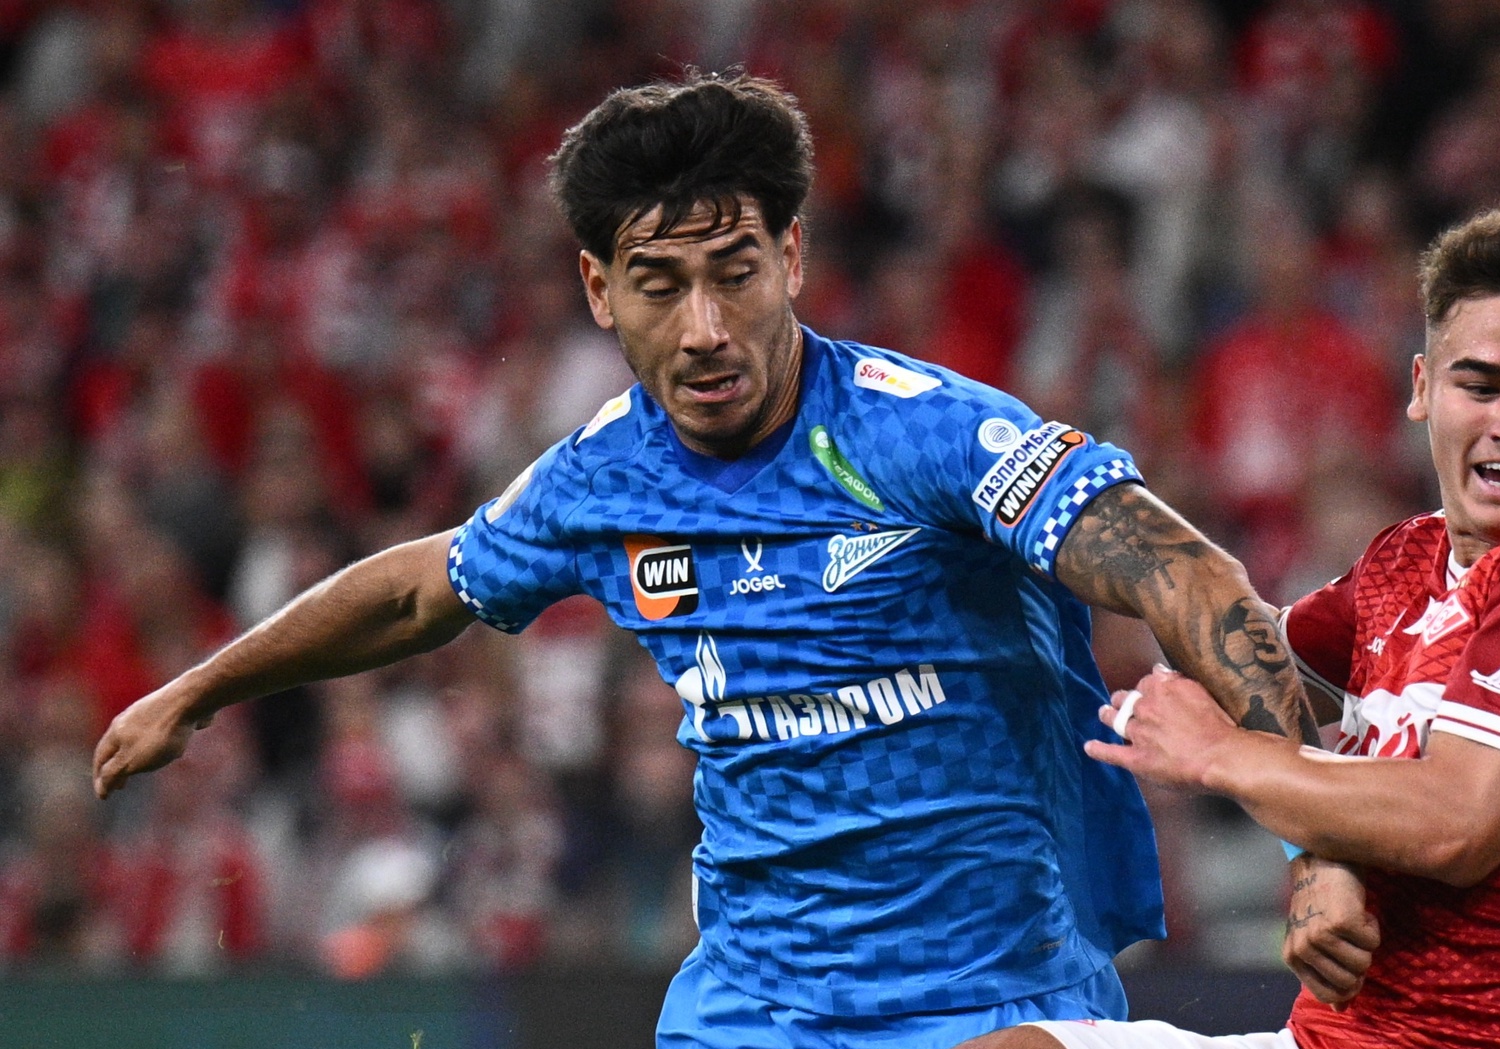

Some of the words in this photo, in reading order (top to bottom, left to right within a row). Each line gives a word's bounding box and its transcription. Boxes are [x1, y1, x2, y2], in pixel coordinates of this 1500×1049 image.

[1000, 438, 1067, 519] WINLINE
[643, 556, 689, 588] WIN
[751, 664, 947, 741] ГАЗПРОМ
